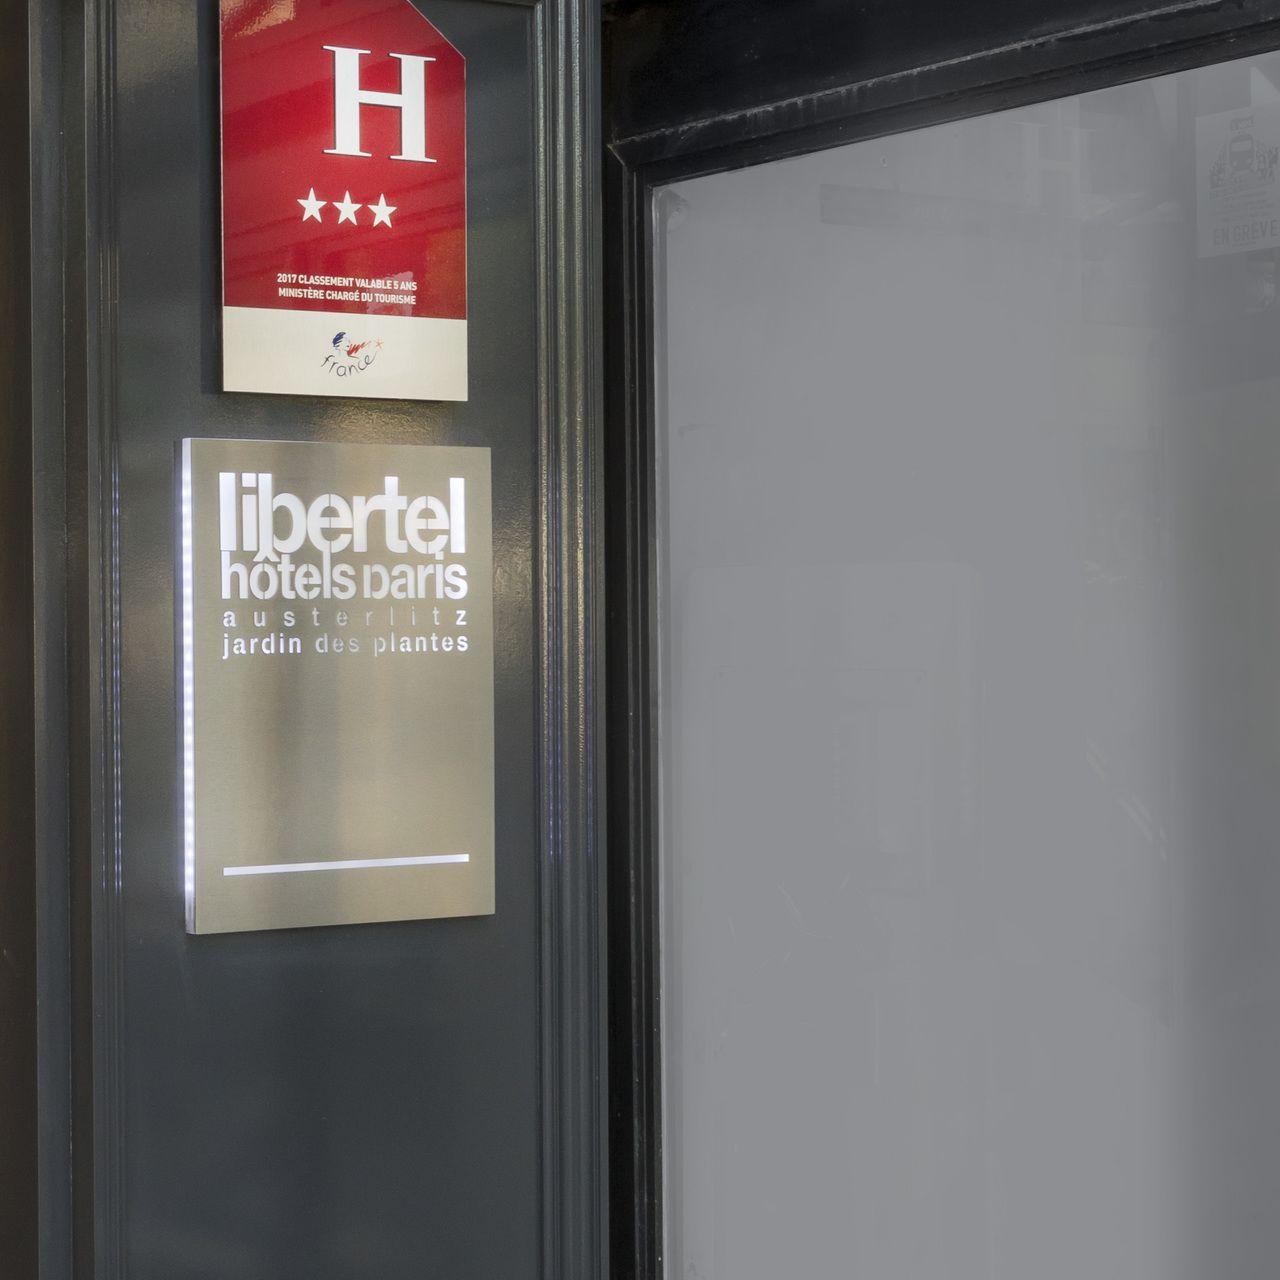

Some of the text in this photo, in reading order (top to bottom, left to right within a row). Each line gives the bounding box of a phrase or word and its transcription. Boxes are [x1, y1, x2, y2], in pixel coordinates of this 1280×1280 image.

[322, 45, 437, 164] H
[277, 273, 418, 292] 2017 CLASSEMENT VALABLE 5 ANS
[278, 287, 417, 306] MINISTÈRE CHARGÉ DU TOURISME
[219, 472, 466, 554] libertel
[221, 550, 469, 600] hôtels paris
[222, 632, 469, 660] jardin des plantes
